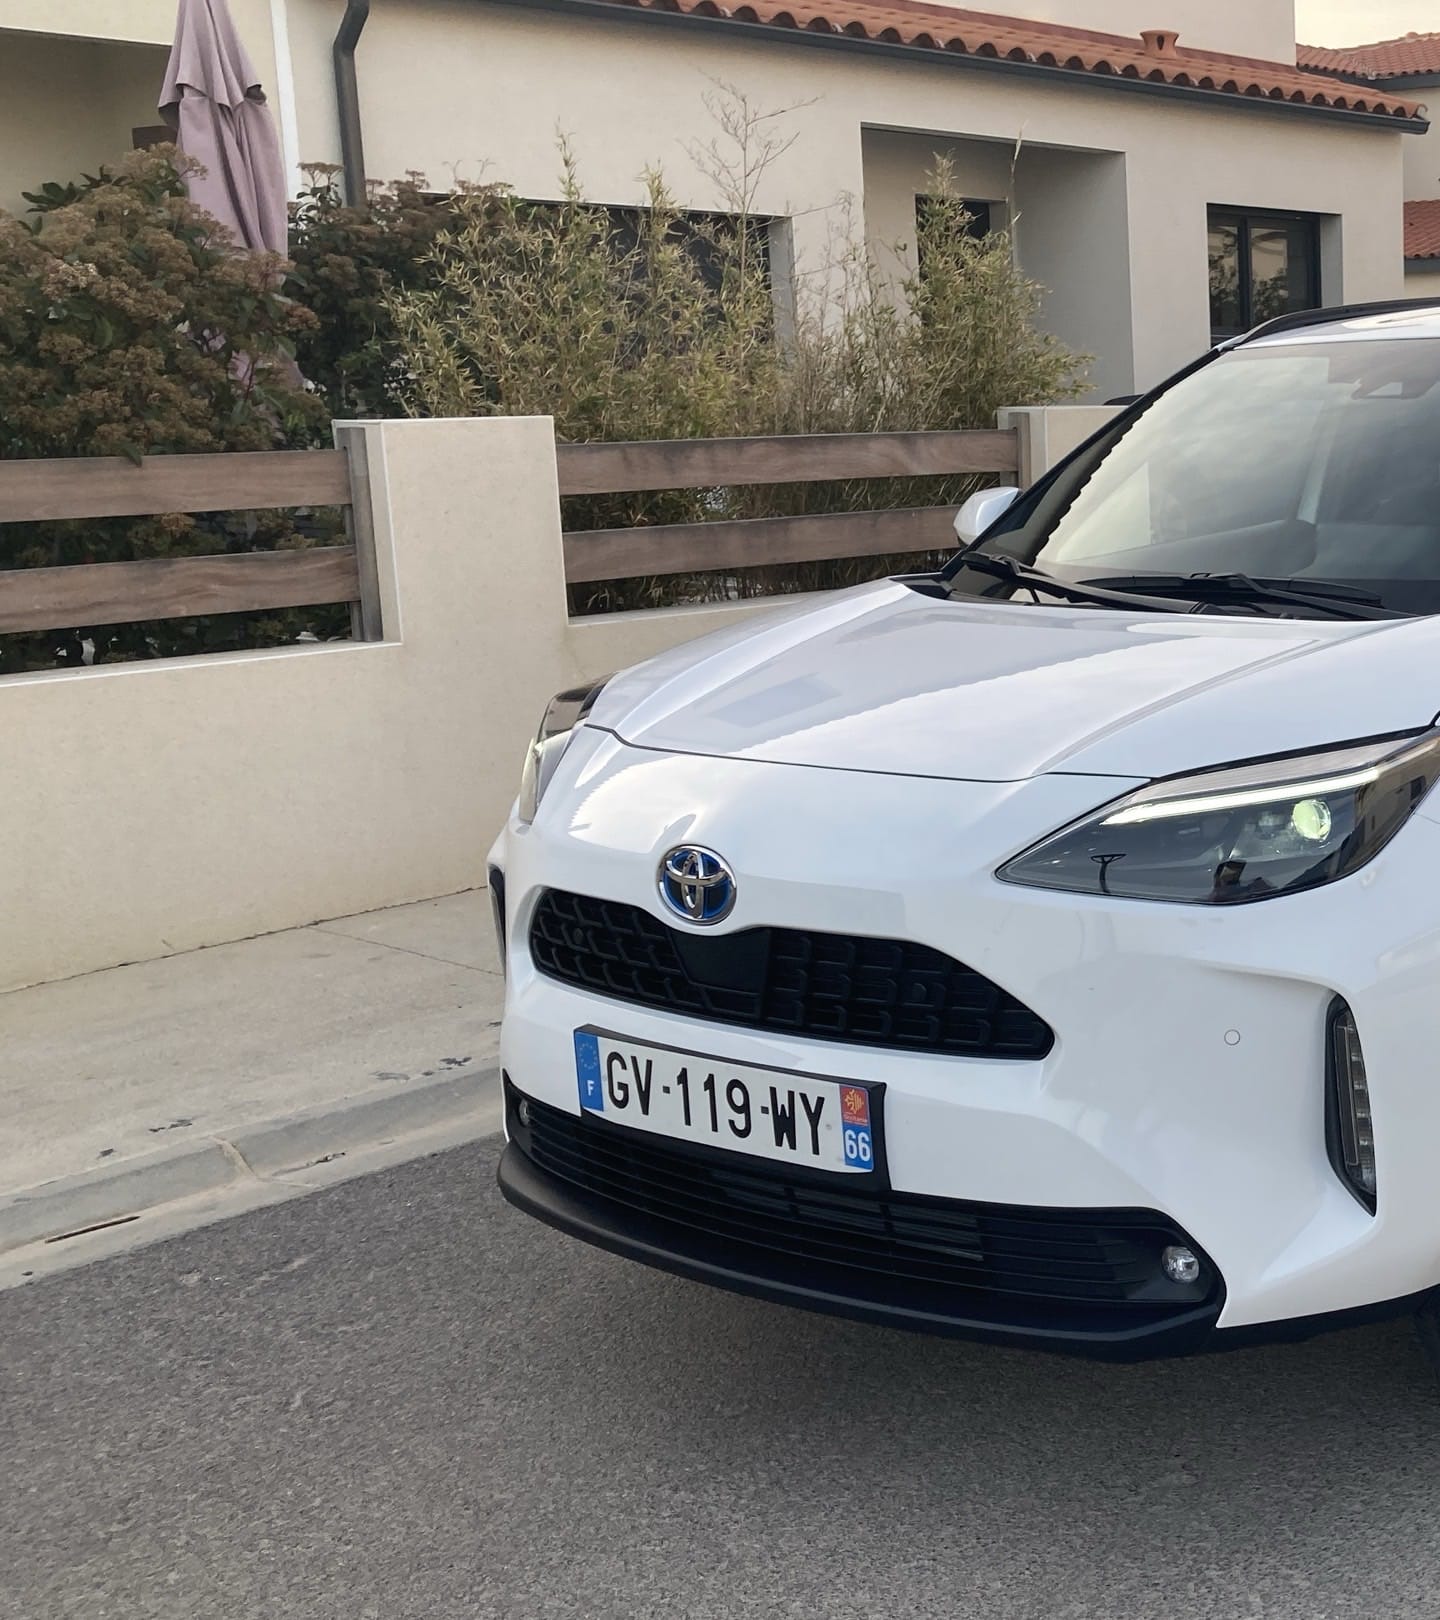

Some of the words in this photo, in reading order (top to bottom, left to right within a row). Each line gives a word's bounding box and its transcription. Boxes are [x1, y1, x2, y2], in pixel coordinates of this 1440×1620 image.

[587, 1080, 595, 1096] F
[606, 1051, 825, 1155] GV-119-WY
[845, 1129, 871, 1162] 66
